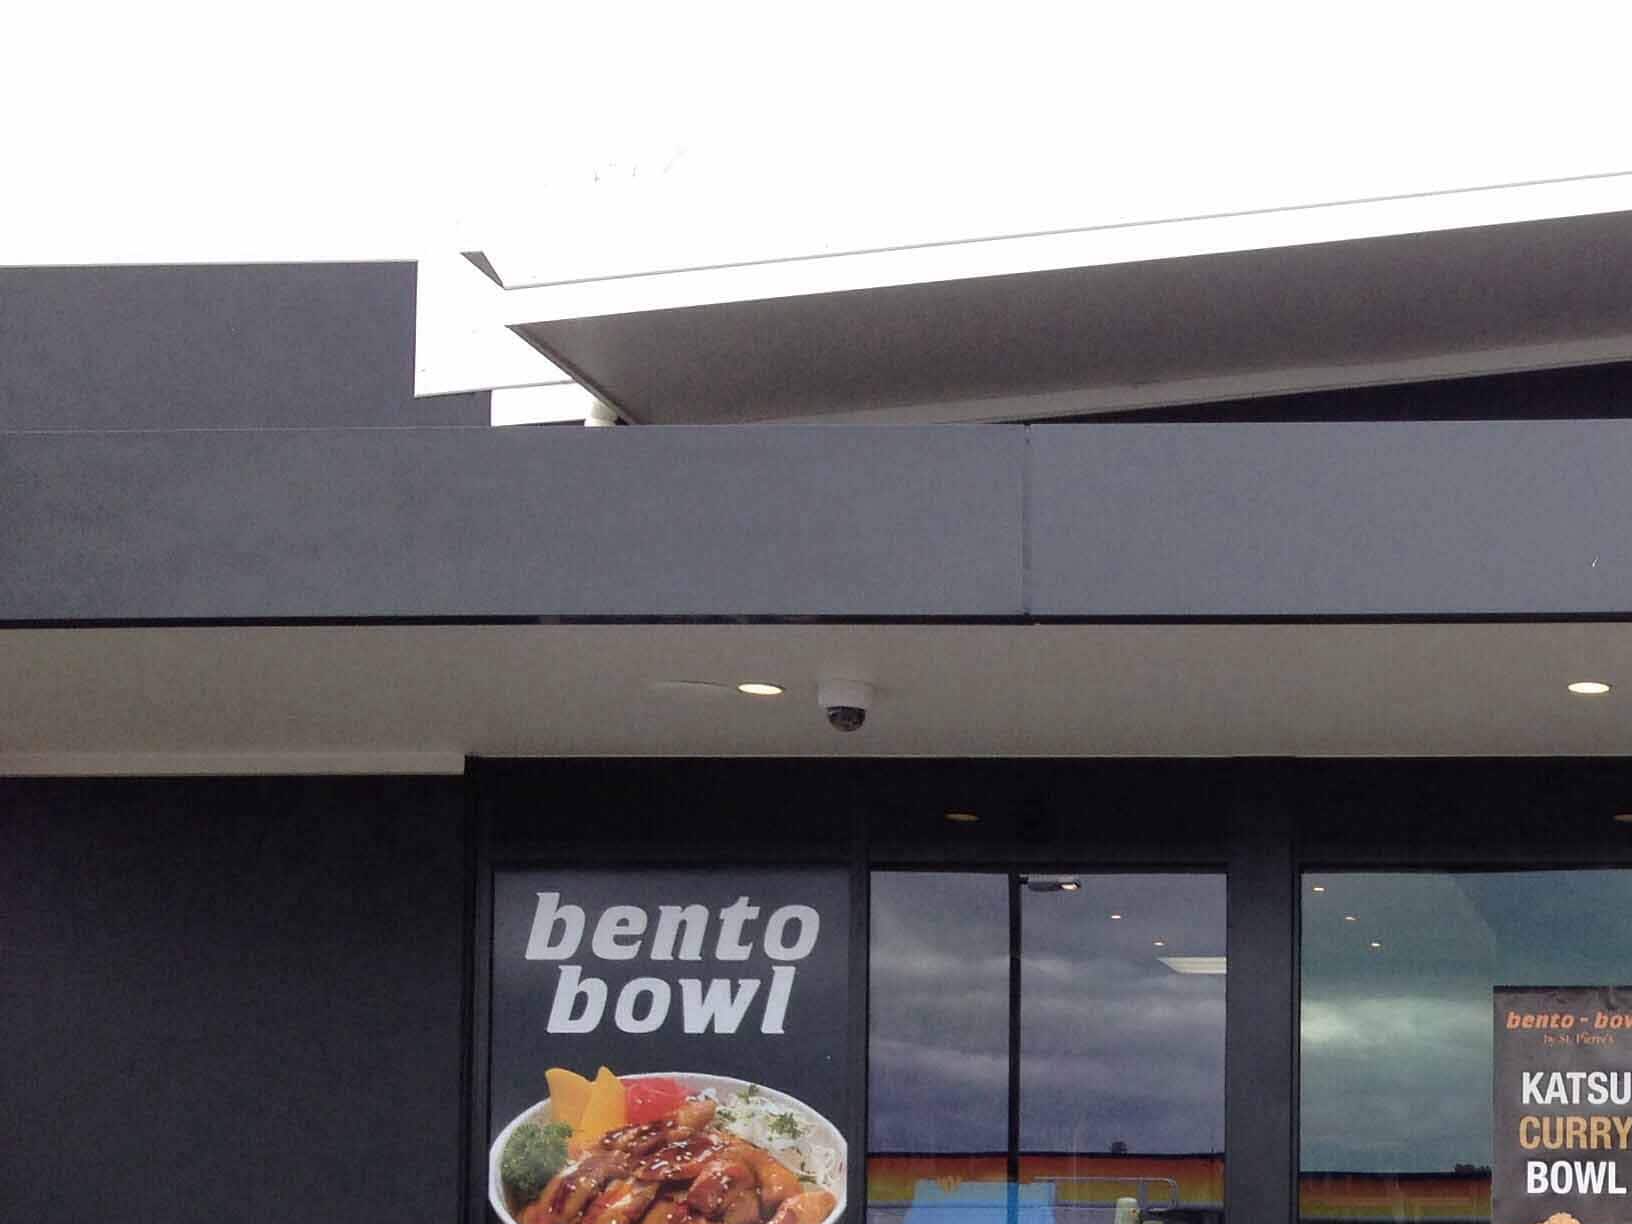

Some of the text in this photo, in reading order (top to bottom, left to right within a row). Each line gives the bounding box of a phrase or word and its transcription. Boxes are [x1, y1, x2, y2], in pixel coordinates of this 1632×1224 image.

[525, 892, 821, 961] bento
[546, 965, 797, 1034] bowl
[1506, 1011, 1575, 1030] bento
[1522, 1072, 1632, 1104] KATSU
[1527, 1161, 1626, 1194] BOWL
